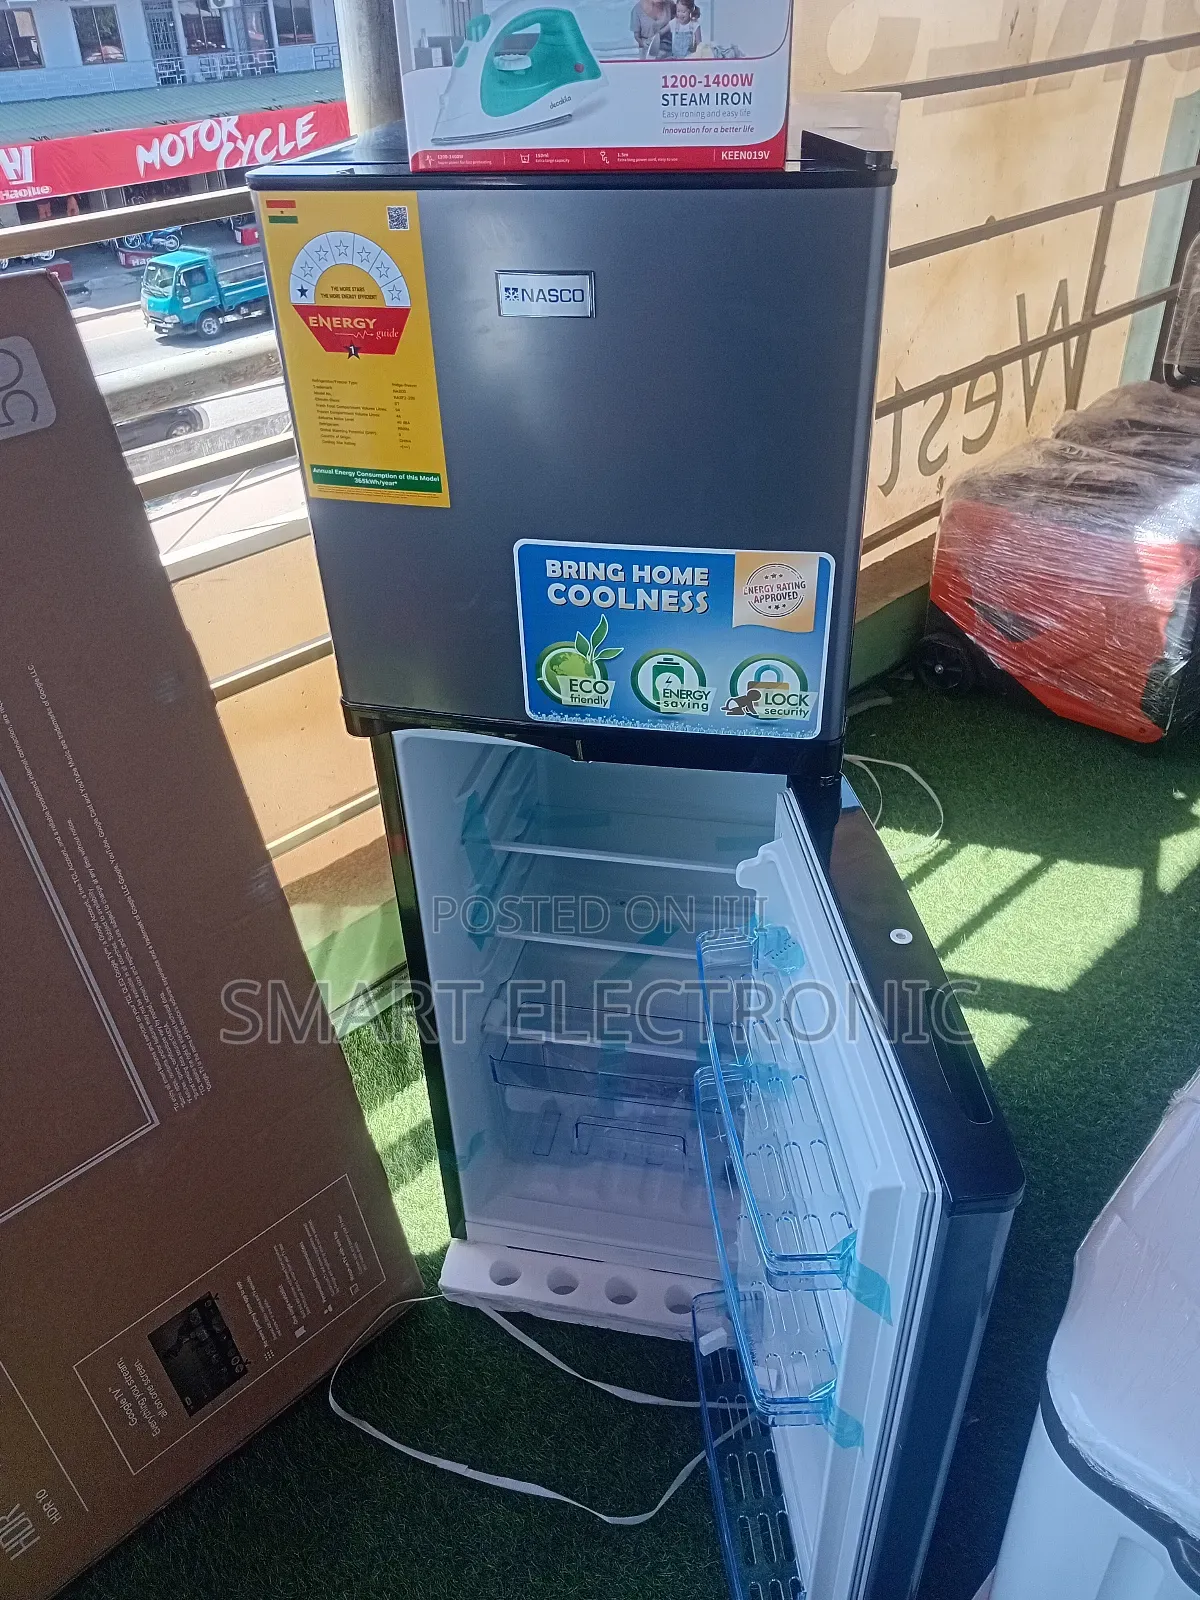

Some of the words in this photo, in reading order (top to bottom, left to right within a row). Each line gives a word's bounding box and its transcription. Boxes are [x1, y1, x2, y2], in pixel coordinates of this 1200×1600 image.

[661, 73, 754, 88] 1200-1400W
[661, 92, 710, 107] STEAM
[715, 92, 753, 106] IRON
[662, 110, 679, 120] Easy
[680, 109, 706, 120] ironing
[706, 109, 721, 118] and
[722, 110, 738, 119] easy
[739, 108, 751, 117] life
[662, 126, 700, 134] Innovation
[701, 125, 713, 134] for
[720, 125, 741, 133] better
[742, 125, 755, 133] life
[136, 115, 242, 178] MOTOR
[216, 111, 319, 170] CYCLE
[721, 150, 771, 161] KEEN019V
[521, 288, 584, 303] NASCO
[308, 313, 377, 332] ENERGY
[376, 328, 399, 340] guide
[312, 467, 334, 475] Annual
[335, 469, 356, 478] Energy
[356, 471, 397, 480] Consumption
[545, 559, 624, 583] BRING
[632, 564, 710, 587] HOME
[776, 579, 806, 594] RATING
[546, 582, 710, 615] COOLNESS
[753, 590, 799, 605] APPROVED
[33, 677, 47, 699] Google
[569, 678, 609, 694] ECO
[662, 688, 711, 701] ENERGY
[569, 692, 609, 708] friendly
[662, 699, 710, 713] saving
[764, 691, 810, 707] LOCK
[764, 706, 810, 719] security
[45, 706, 63, 739] trademarks
[6, 723, 26, 758] connection,
[63, 749, 75, 767] Music
[21, 757, 35, 780] internet
[71, 766, 86, 793] YouTube
[31, 780, 48, 810] broadband
[92, 816, 106, 837] Google
[125, 894, 138, 915] Google
[93, 921, 106, 941] Google
[109, 958, 122, 978] Google
[113, 1356, 136, 1386] stream,
[132, 1357, 151, 1385] screen.
[129, 1382, 144, 1400] you
[146, 1383, 158, 1400] one
[116, 1396, 140, 1427] Google
[153, 1397, 164, 1409] on
[134, 1396, 163, 1437] Everything
[157, 1407, 168, 1419] all
[35, 1488, 49, 1504] 10
[43, 1499, 62, 1525] HDR
